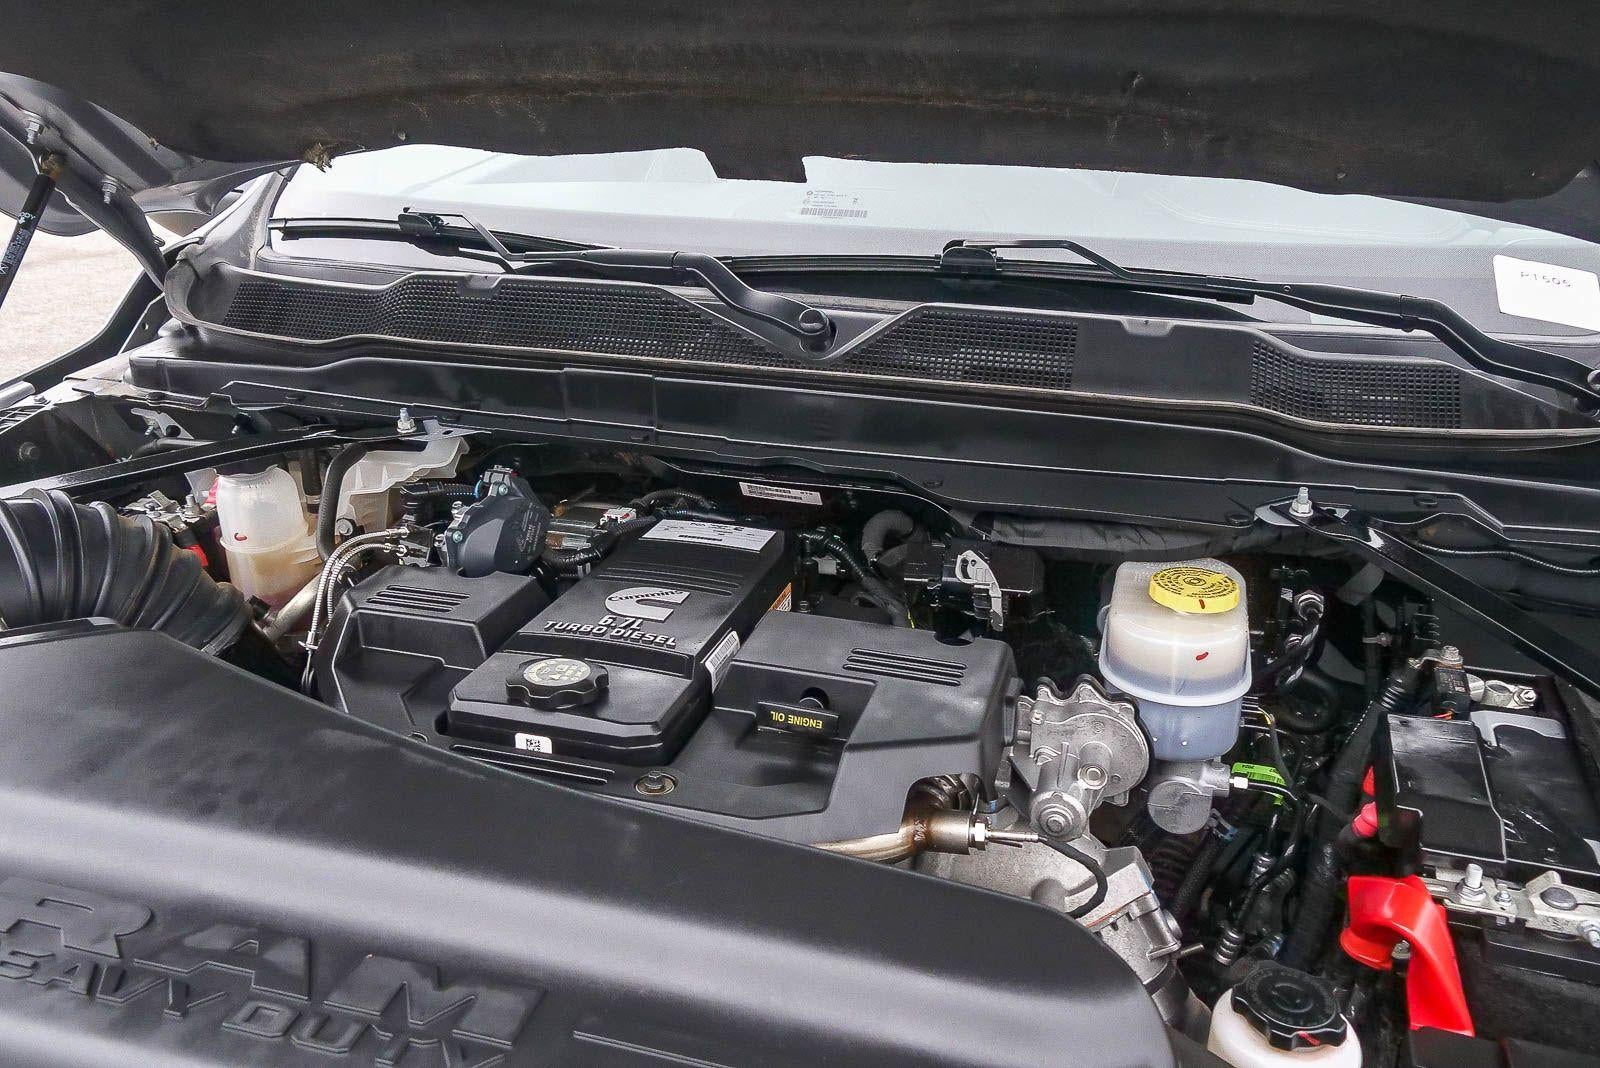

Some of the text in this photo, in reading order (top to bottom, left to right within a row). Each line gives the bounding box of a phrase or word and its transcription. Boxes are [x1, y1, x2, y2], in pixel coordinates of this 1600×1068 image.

[607, 589, 684, 602] Cummins
[544, 620, 677, 649] TURBO DIESEL
[598, 614, 644, 631] 6.7L
[770, 710, 823, 729] ENGINE OIL
[0, 876, 549, 1048] RAM
[0, 937, 229, 1018] EAVY
